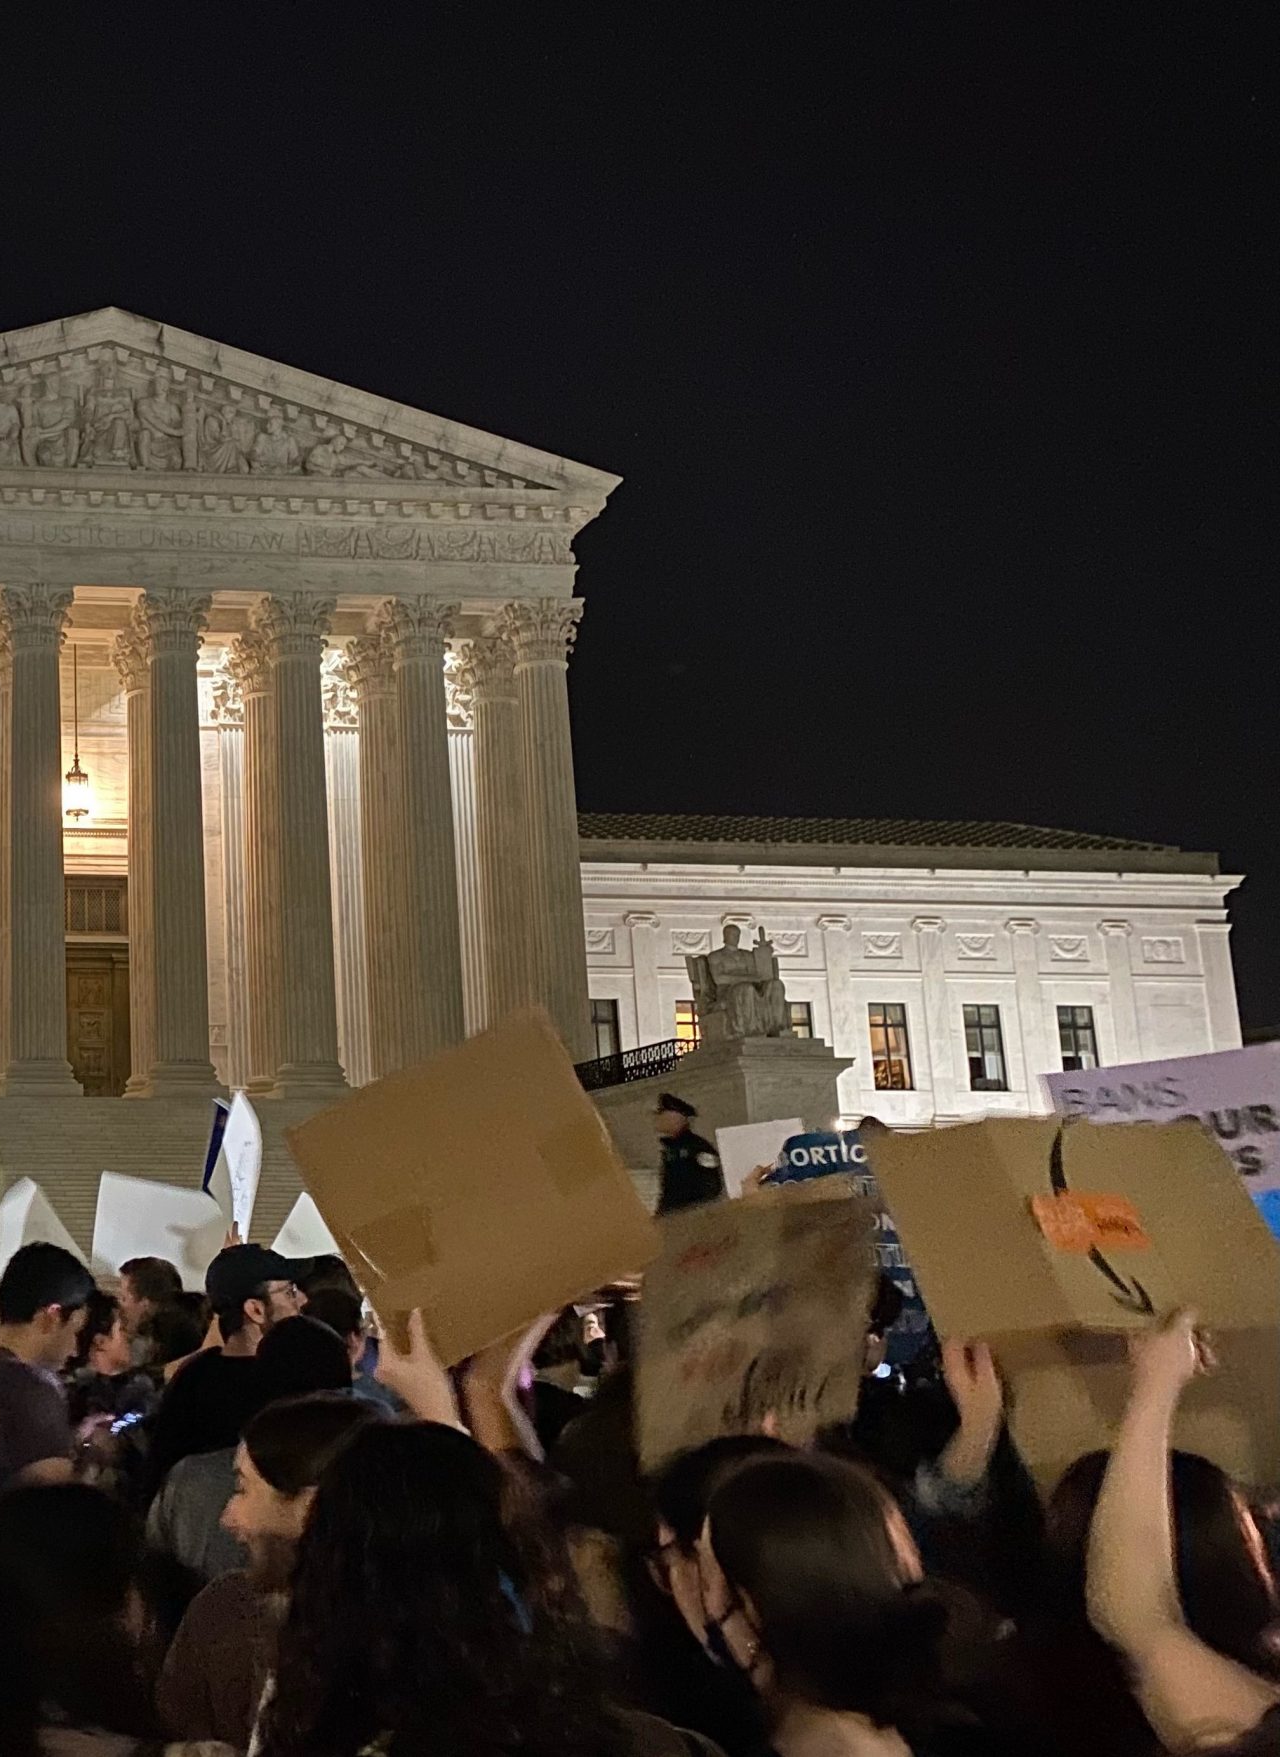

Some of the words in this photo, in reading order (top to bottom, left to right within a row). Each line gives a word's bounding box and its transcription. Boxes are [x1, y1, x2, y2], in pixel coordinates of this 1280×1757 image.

[27, 521, 126, 548] JUSTICE
[139, 526, 225, 550] UNDER
[233, 530, 284, 551] LAW
